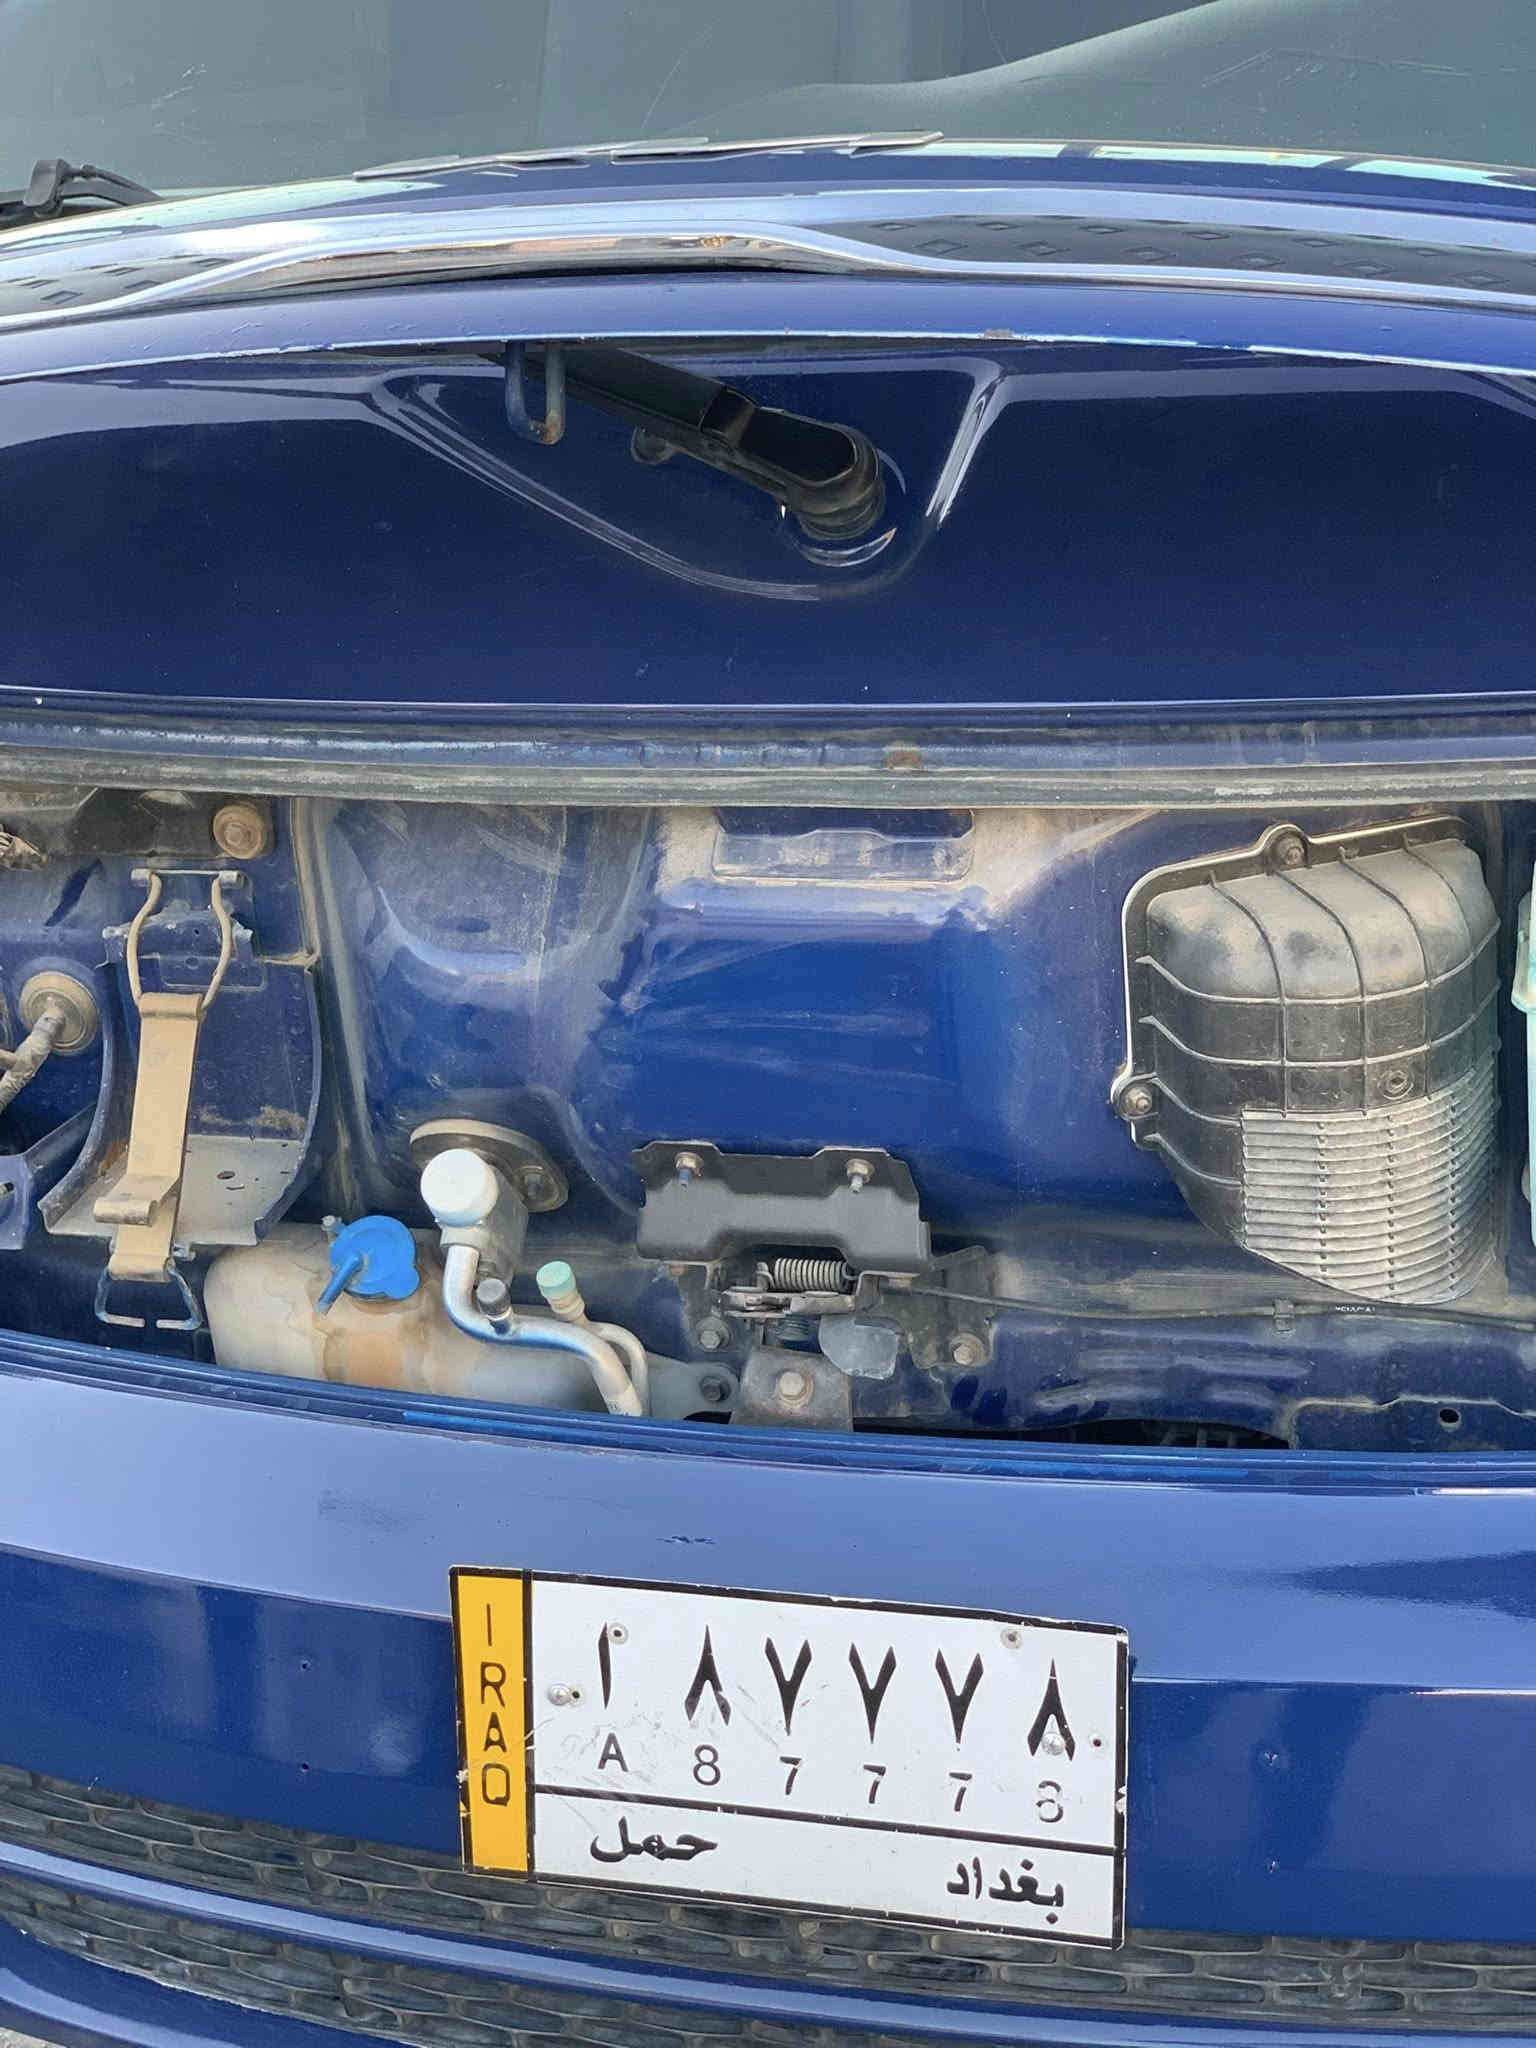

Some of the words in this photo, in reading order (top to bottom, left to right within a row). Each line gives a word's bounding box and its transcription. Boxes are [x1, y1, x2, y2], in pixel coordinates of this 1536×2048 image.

[479, 1603, 511, 1807] IRAQ
[590, 1816, 718, 1863] حمل
[946, 1857, 1064, 1925] بغداد
